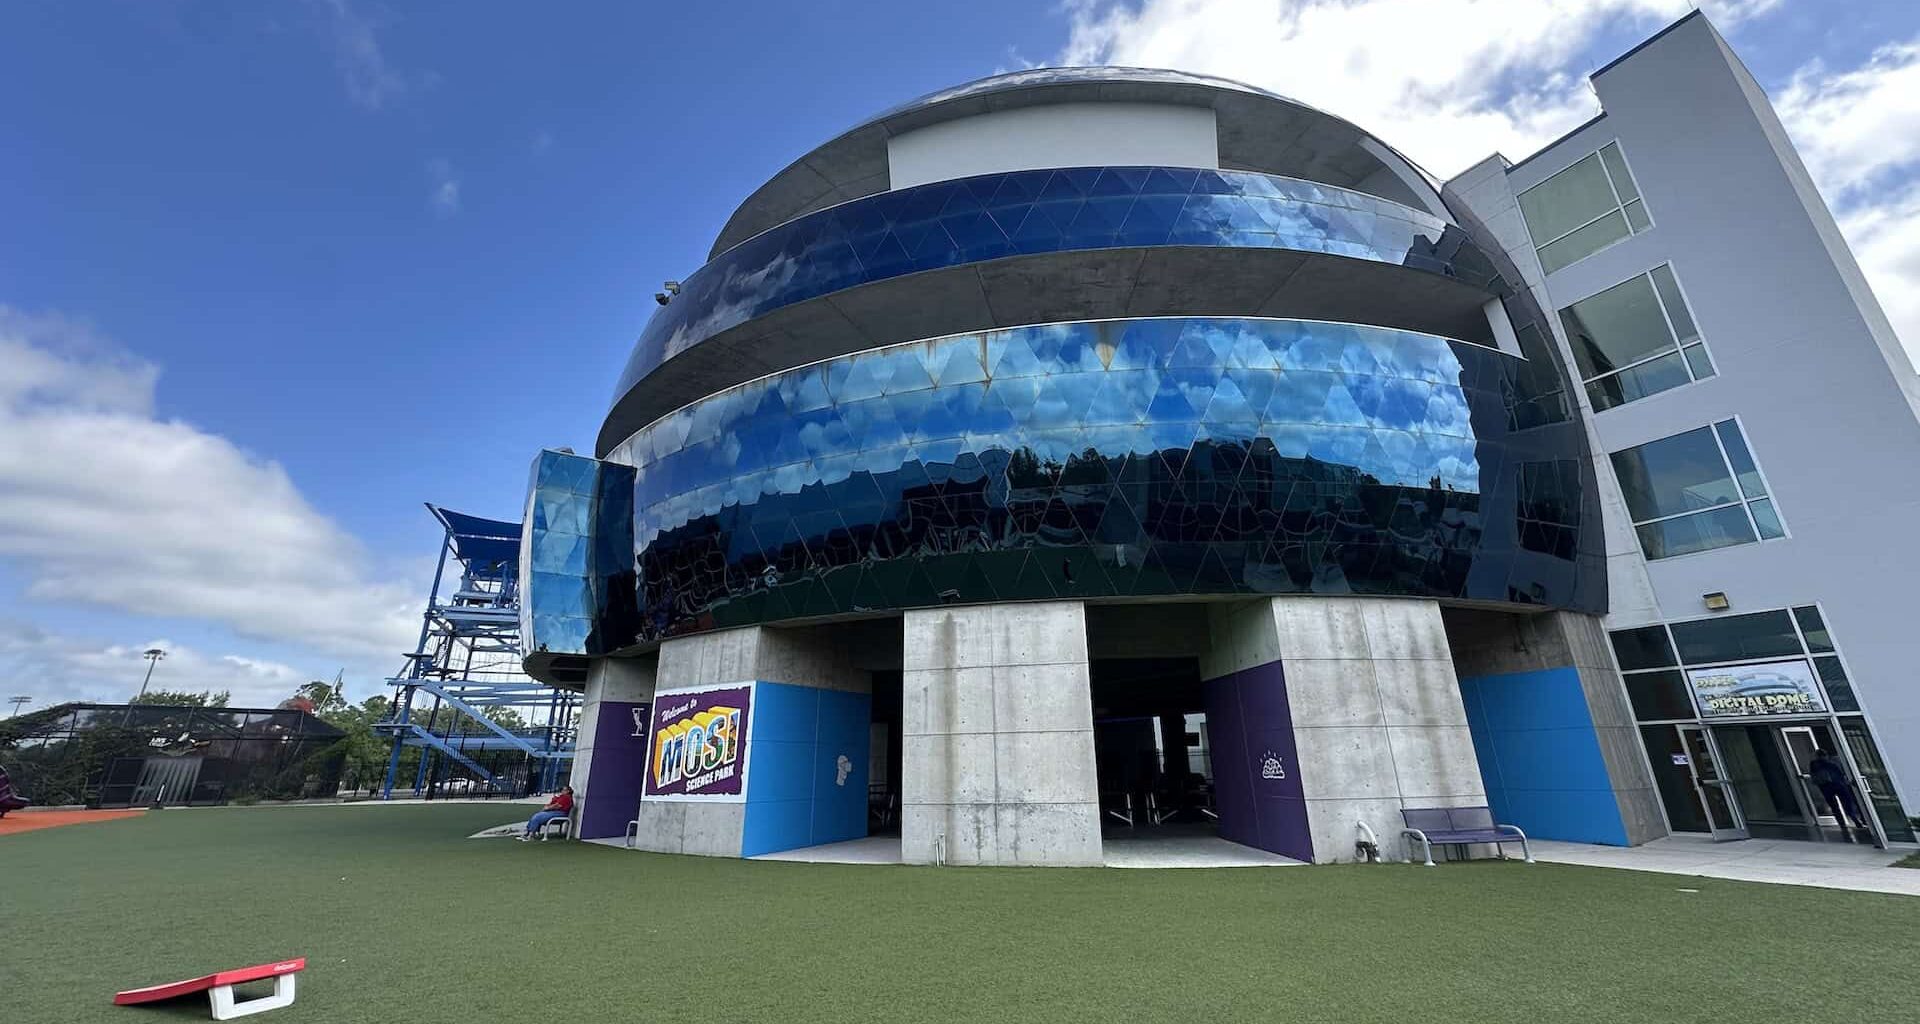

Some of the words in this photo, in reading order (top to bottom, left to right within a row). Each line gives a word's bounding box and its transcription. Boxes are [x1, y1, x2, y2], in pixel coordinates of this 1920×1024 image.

[661, 703, 689, 722] Welcome
[1711, 697, 1764, 709] DIGITAL
[1765, 693, 1809, 706] DOME
[655, 707, 741, 789] MOSI
[686, 772, 714, 792] SCIENCE
[714, 763, 735, 782] PARK
